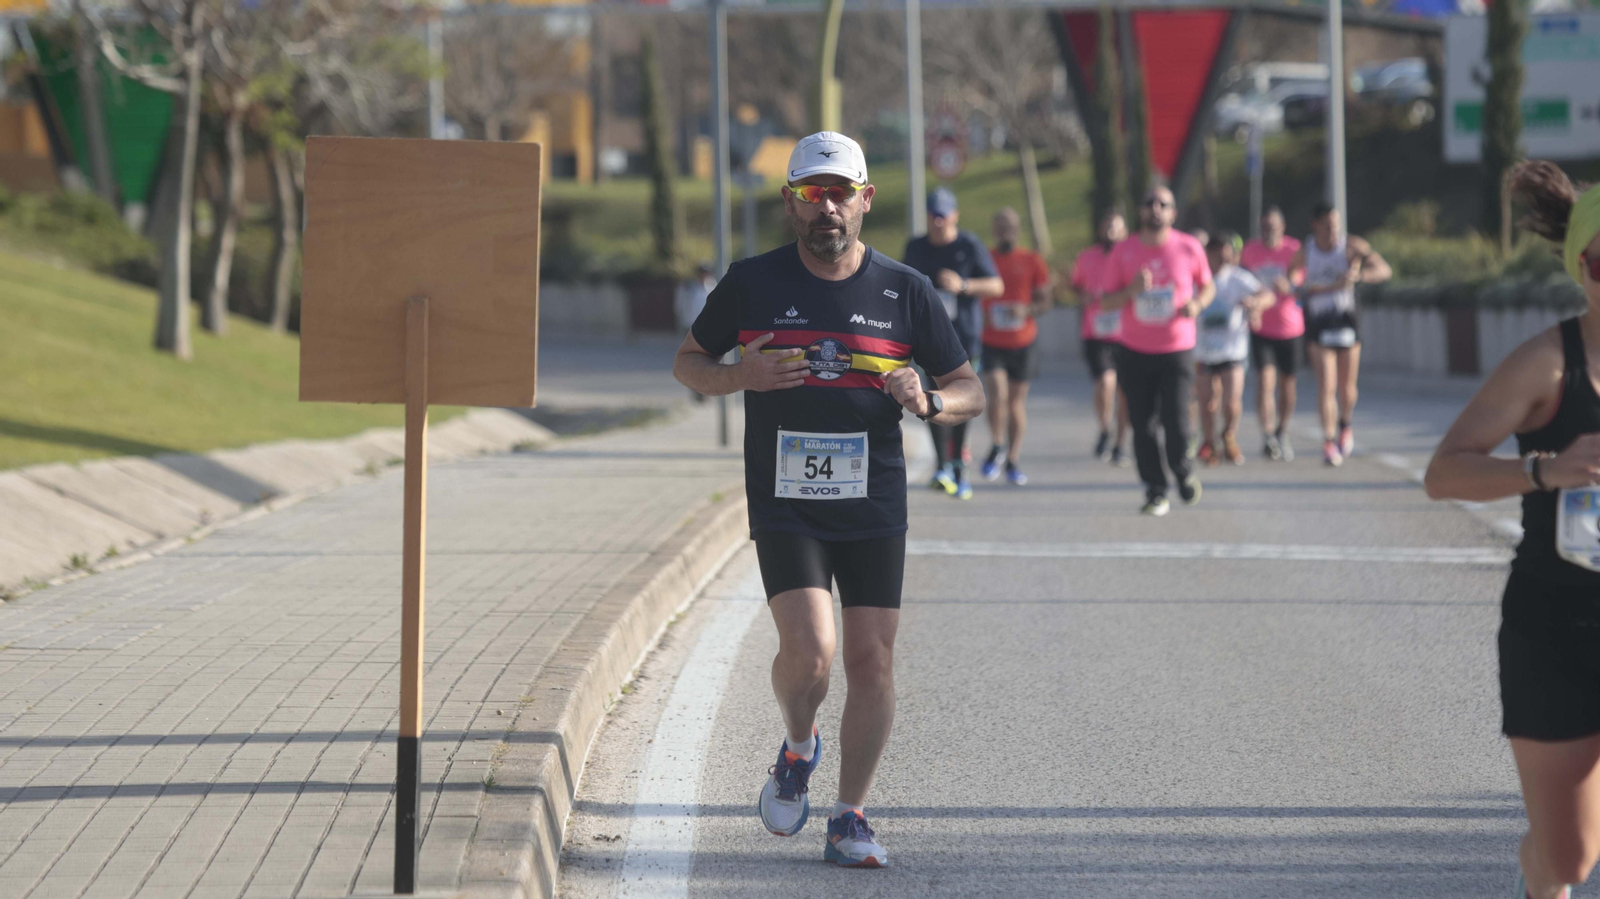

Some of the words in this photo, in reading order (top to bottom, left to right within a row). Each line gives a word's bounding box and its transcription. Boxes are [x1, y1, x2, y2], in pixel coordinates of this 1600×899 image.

[774, 317, 809, 325] Santander
[867, 319, 892, 330] mupol
[804, 442, 841, 450] MARATÓN
[804, 455, 834, 480] 54
[798, 486, 840, 495] EVOS
